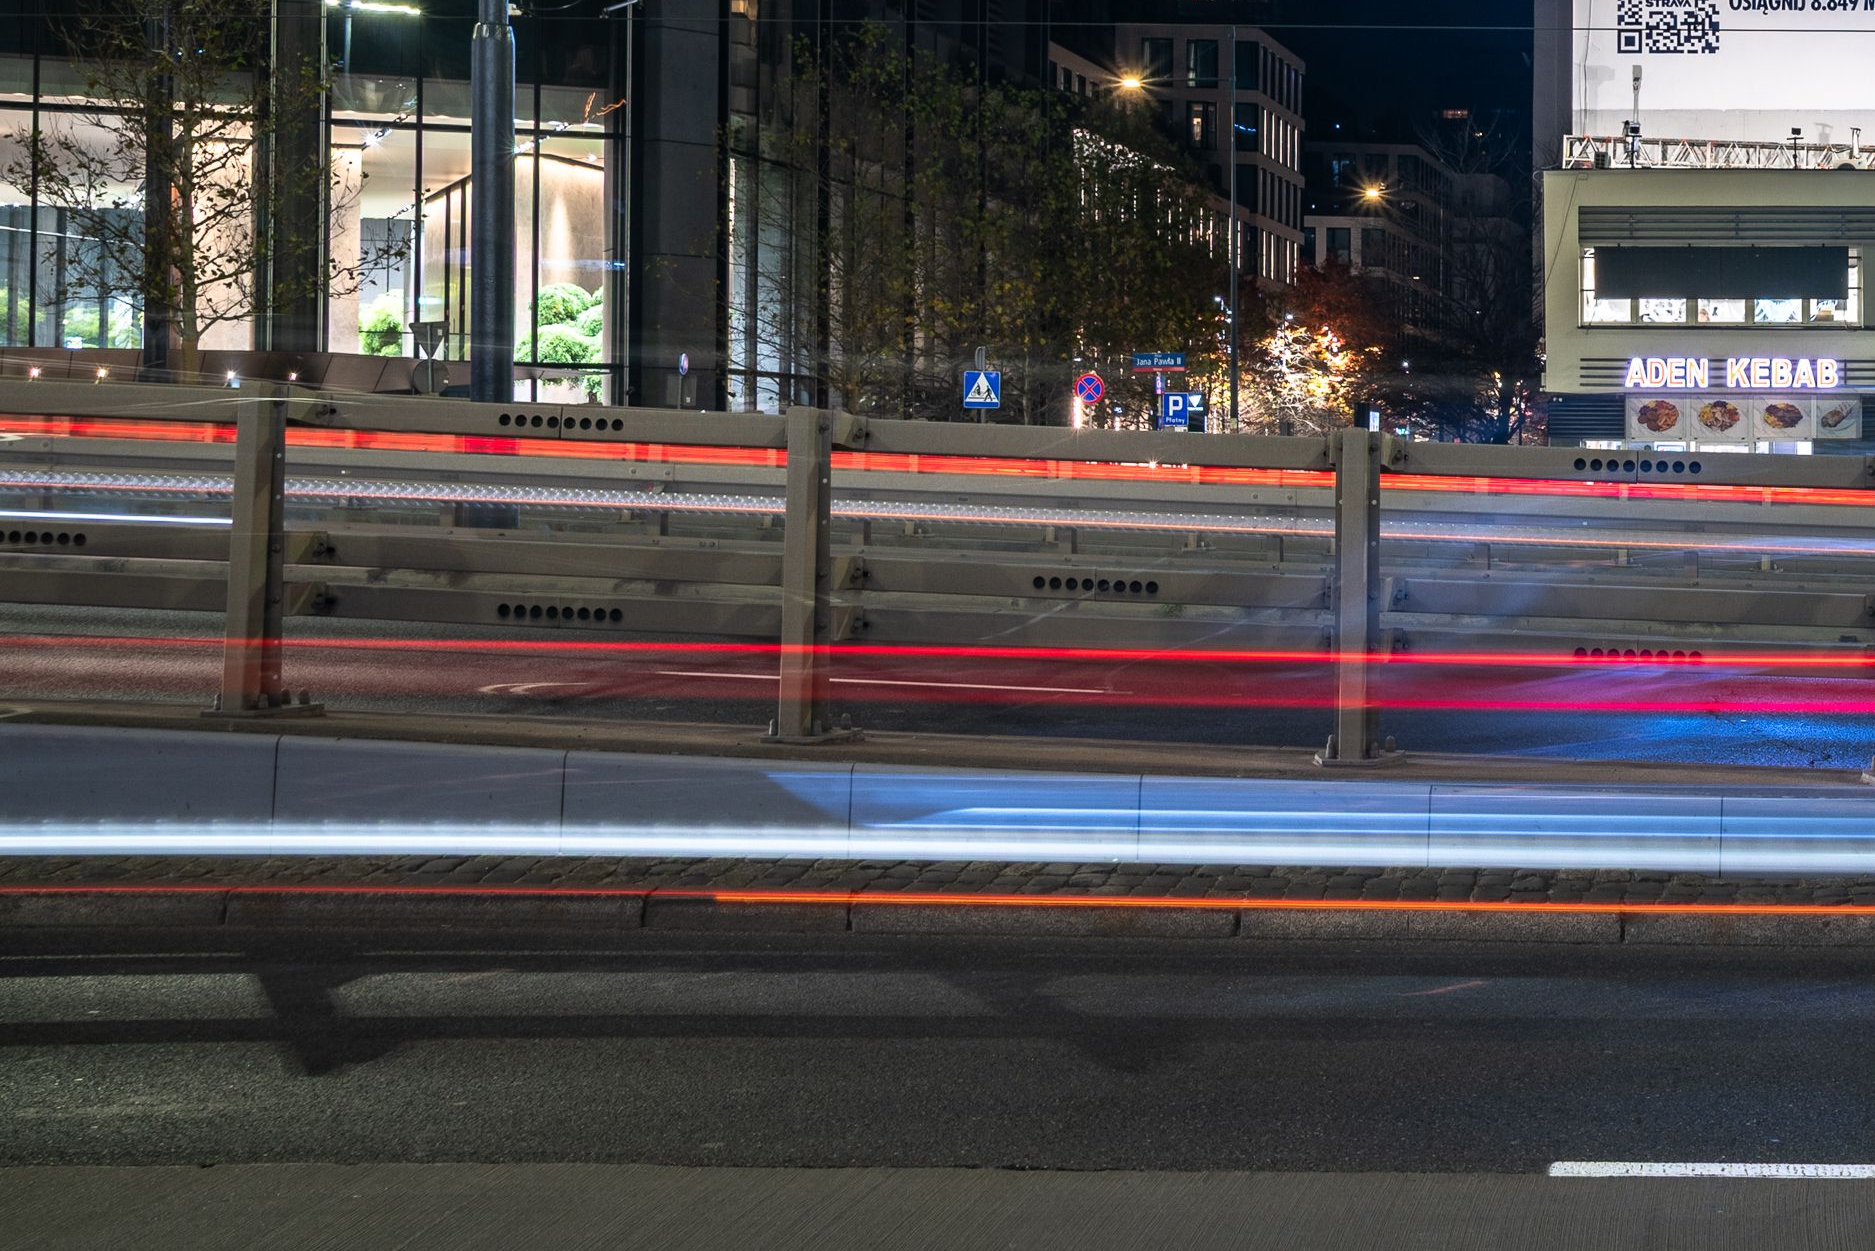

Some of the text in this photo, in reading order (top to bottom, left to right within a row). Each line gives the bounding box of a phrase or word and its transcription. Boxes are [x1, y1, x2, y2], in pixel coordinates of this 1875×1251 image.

[1137, 357, 1182, 366] Jana Pawła II
[1625, 357, 1838, 388] ADEN KEBAB
[1169, 396, 1183, 416] P
